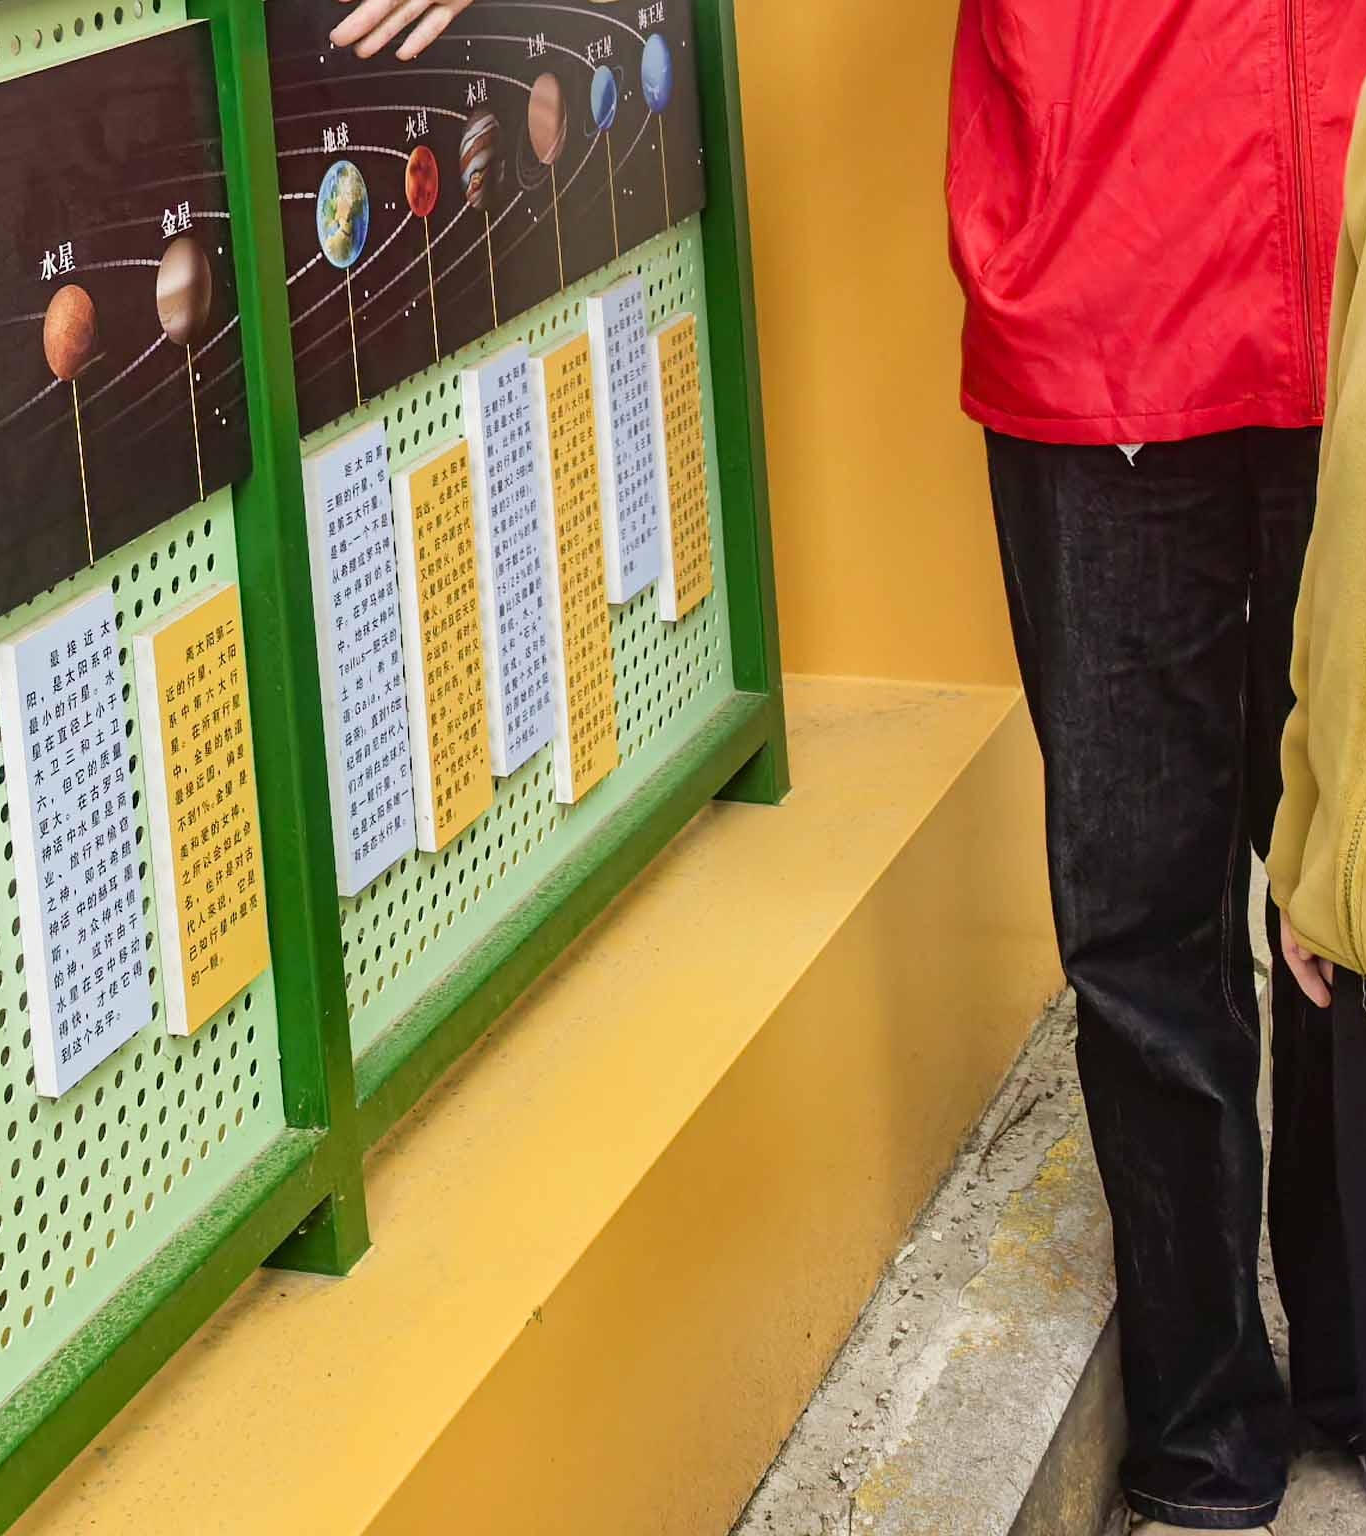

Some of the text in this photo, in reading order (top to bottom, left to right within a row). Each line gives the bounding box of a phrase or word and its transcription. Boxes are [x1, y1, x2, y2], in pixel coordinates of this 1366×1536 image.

[526, 32, 547, 59] 土星
[586, 35, 613, 66] 天王星
[465, 78, 488, 105] 木星
[322, 124, 350, 155] 地球
[405, 109, 430, 144] 火星
[160, 200, 193, 239] 金星
[38, 240, 75, 282] 水星
